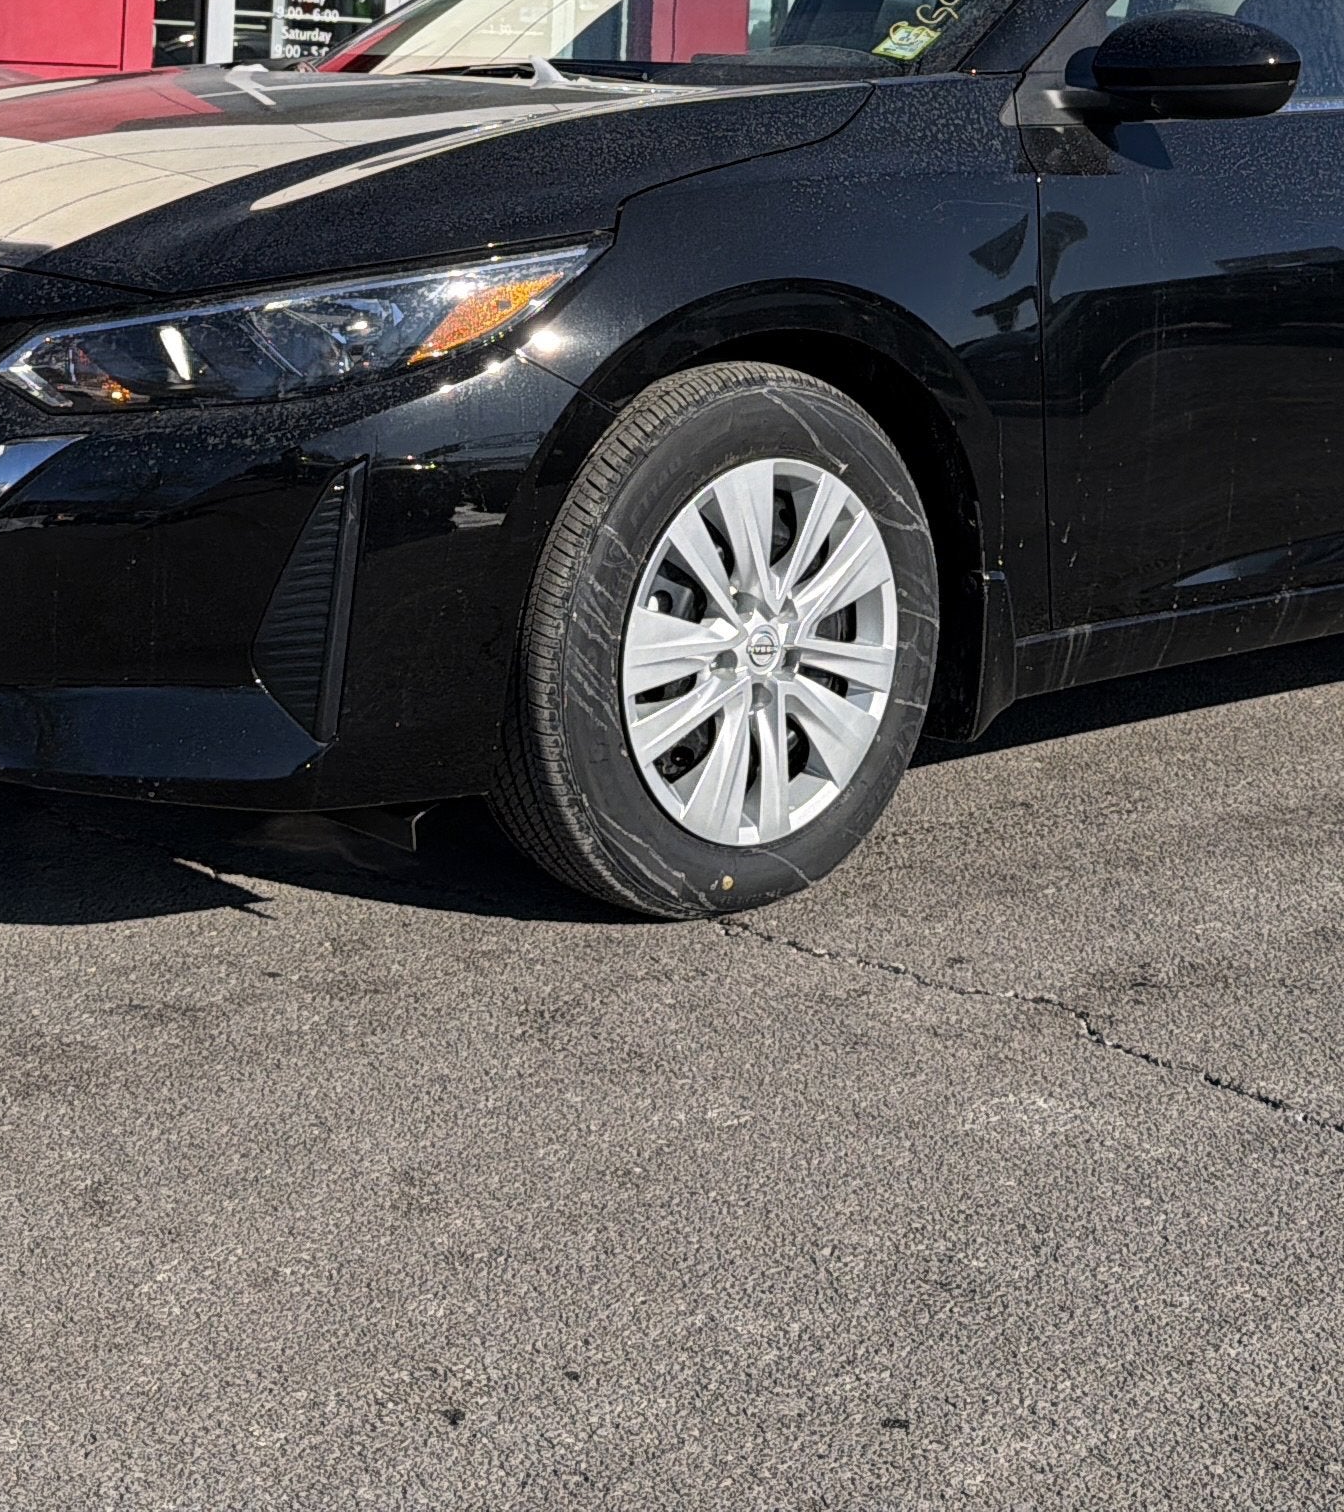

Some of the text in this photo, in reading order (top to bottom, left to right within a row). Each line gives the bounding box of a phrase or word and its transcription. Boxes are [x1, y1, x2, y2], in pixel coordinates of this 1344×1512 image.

[312, 9, 339, 23] 6:00
[281, 26, 332, 44] Saturday
[275, 44, 301, 58] 9:00
